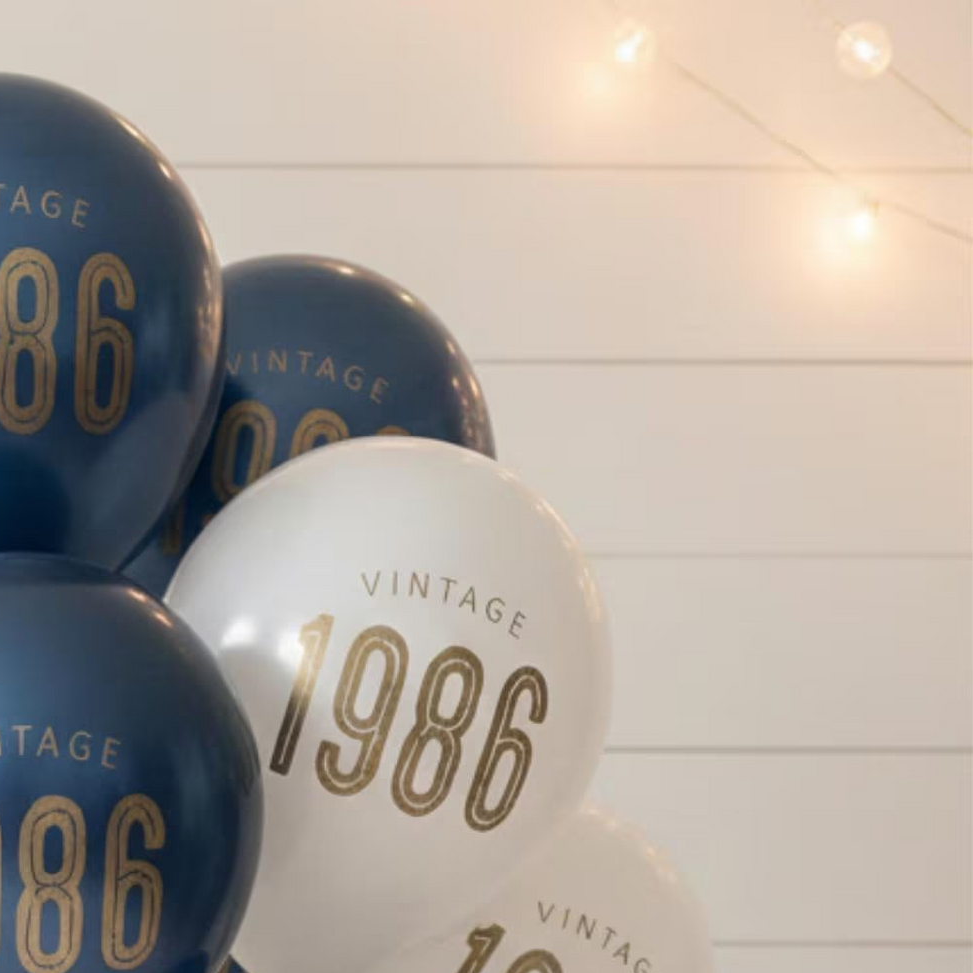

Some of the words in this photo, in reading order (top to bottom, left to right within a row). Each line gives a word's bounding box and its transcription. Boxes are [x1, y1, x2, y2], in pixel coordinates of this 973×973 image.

[226, 350, 389, 404] VINTAGE
[361, 570, 527, 640] VINTAGE
[269, 613, 548, 833] 1986
